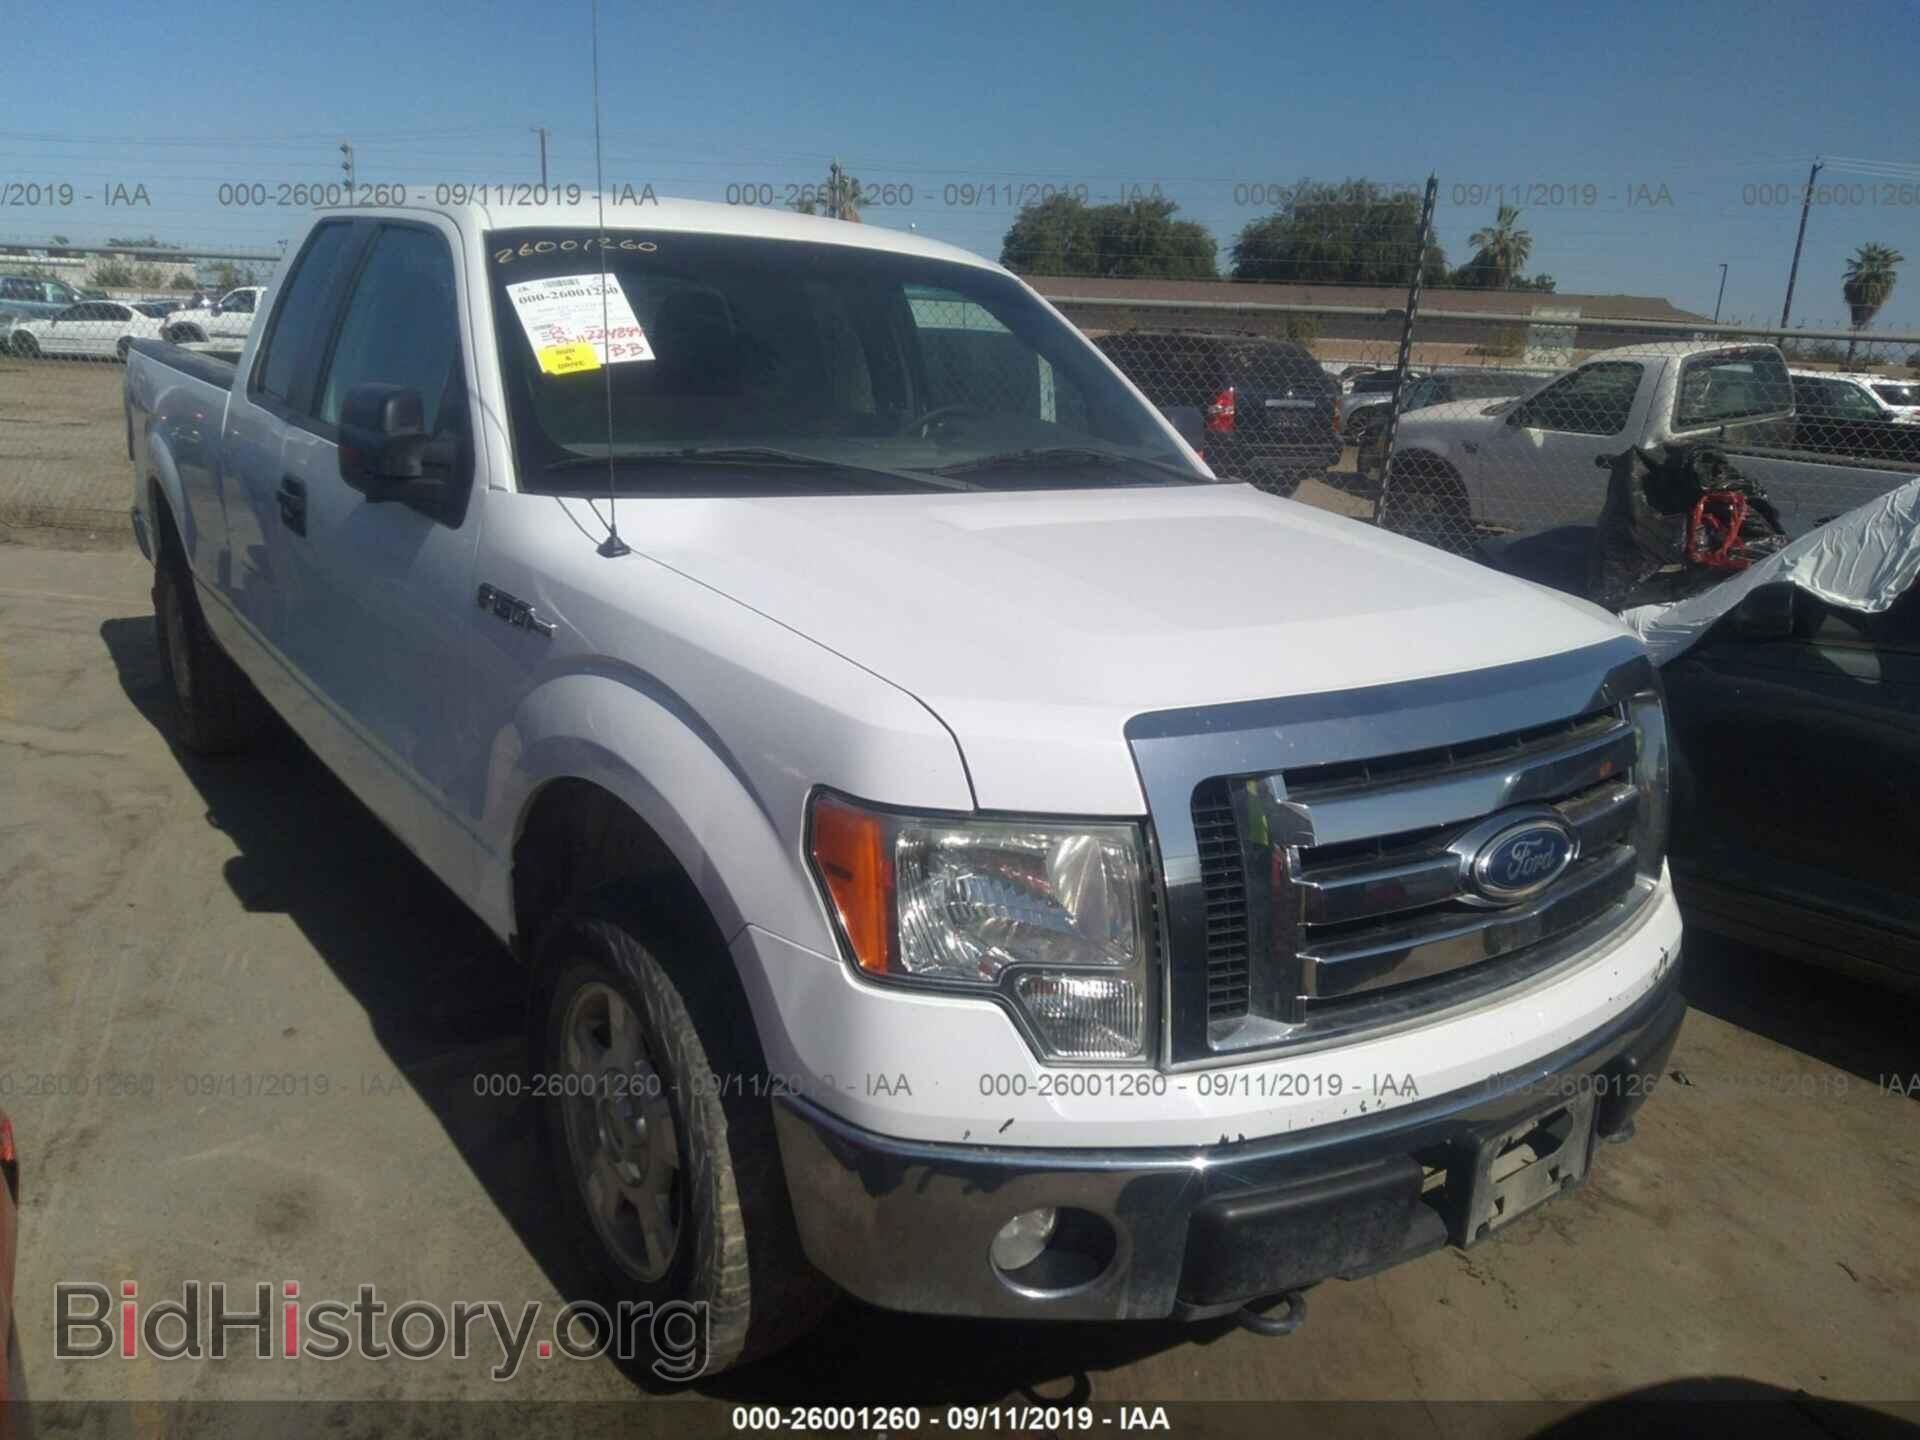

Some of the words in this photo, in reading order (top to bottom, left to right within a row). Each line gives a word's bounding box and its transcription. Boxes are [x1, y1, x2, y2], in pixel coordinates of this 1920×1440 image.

[494, 237, 658, 264] 26001260
[518, 284, 619, 304] 000-26001260
[1506, 837, 1556, 881] Ford
